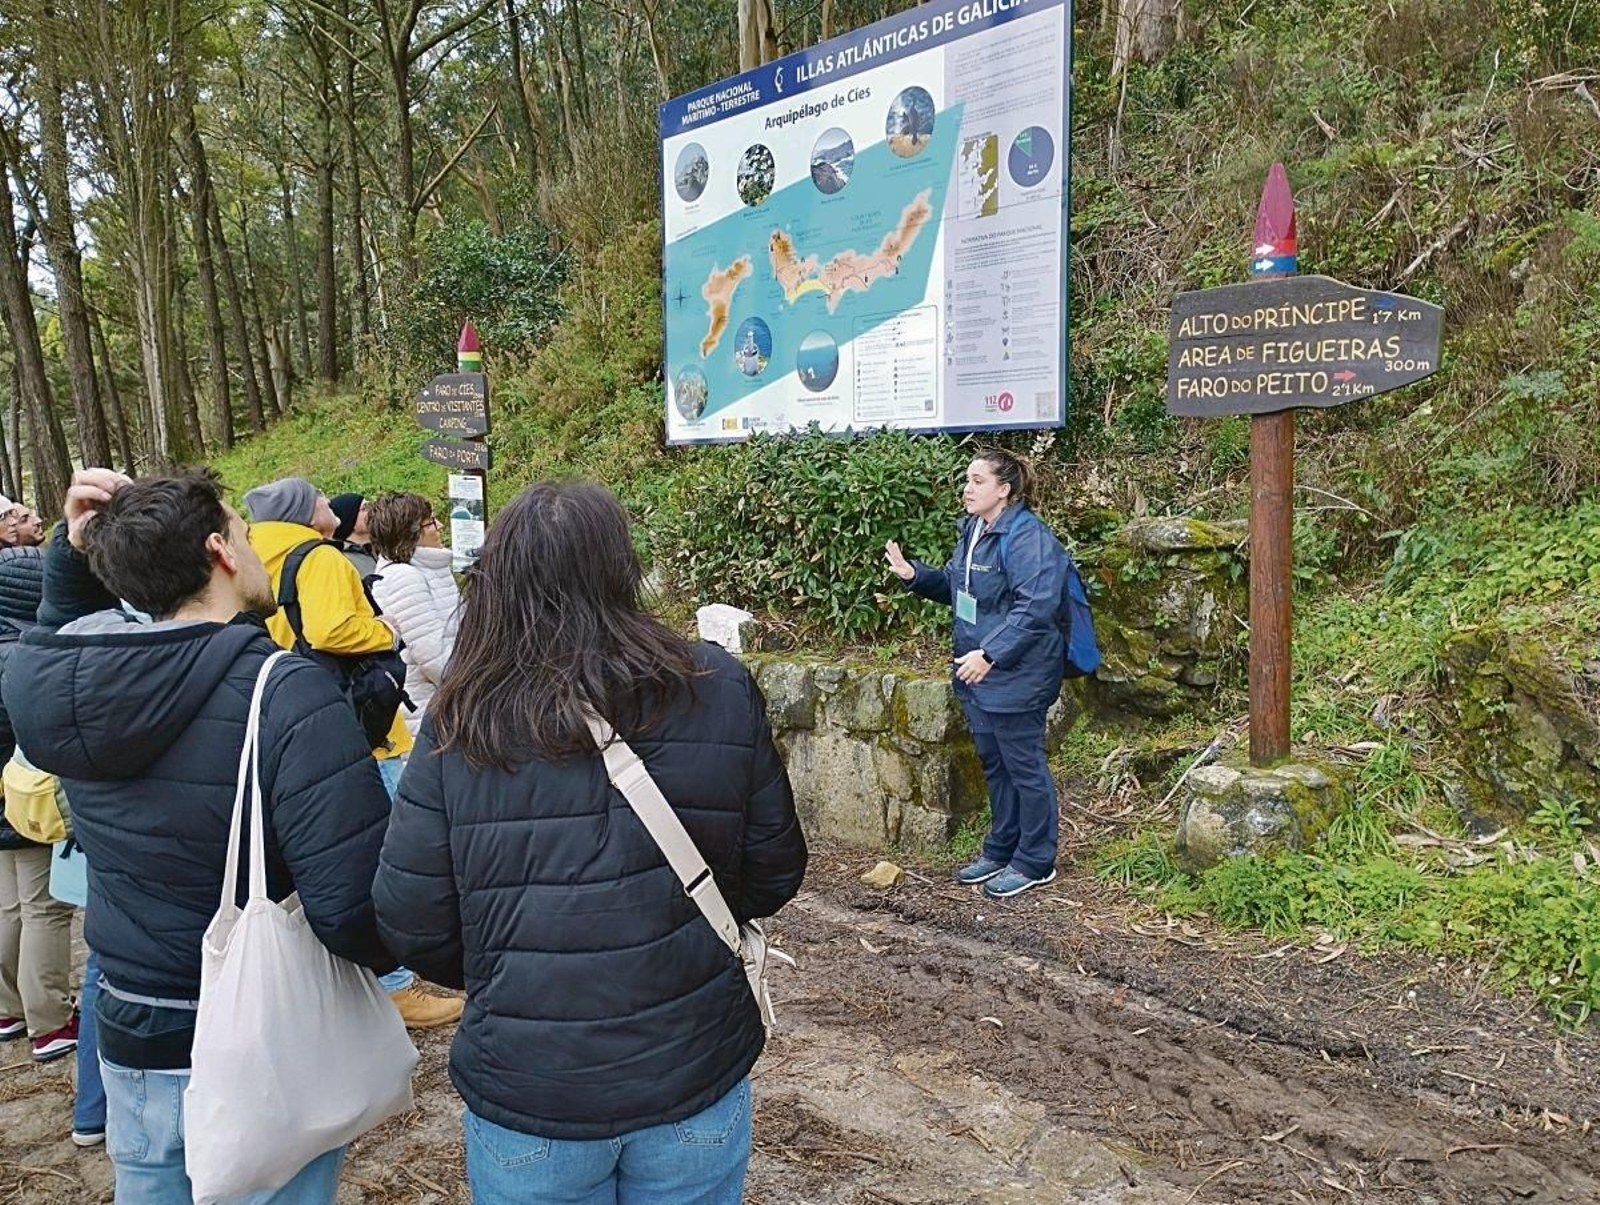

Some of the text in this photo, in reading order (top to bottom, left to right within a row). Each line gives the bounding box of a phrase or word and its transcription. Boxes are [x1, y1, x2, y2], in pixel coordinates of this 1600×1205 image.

[796, 55, 833, 83] ILLAS
[836, 20, 928, 69] ATLÁNTICAS
[932, 11, 954, 36] DE
[957, 0, 1028, 26] GALIC
[687, 81, 753, 113] PARQUE NACIONAL
[721, 89, 760, 112] TERRESTRE
[764, 86, 871, 130] Arquipélago de Cíes
[1178, 313, 1228, 337] ALTO
[1231, 315, 1252, 329] DO
[1254, 297, 1366, 330] PRÍNCIPE
[1397, 309, 1421, 322] Km
[1178, 345, 1232, 368] AREA
[1236, 346, 1255, 360] DE
[1262, 335, 1400, 363] FIGUEIRAS
[1177, 376, 1228, 399] FARO
[1231, 379, 1251, 393] DO
[1256, 371, 1328, 395] PEITO
[416, 401, 440, 414] CENTRO
[446, 400, 485, 412] VISITANTES
[429, 444, 447, 459] FARO
[456, 448, 480, 465] PORTA
